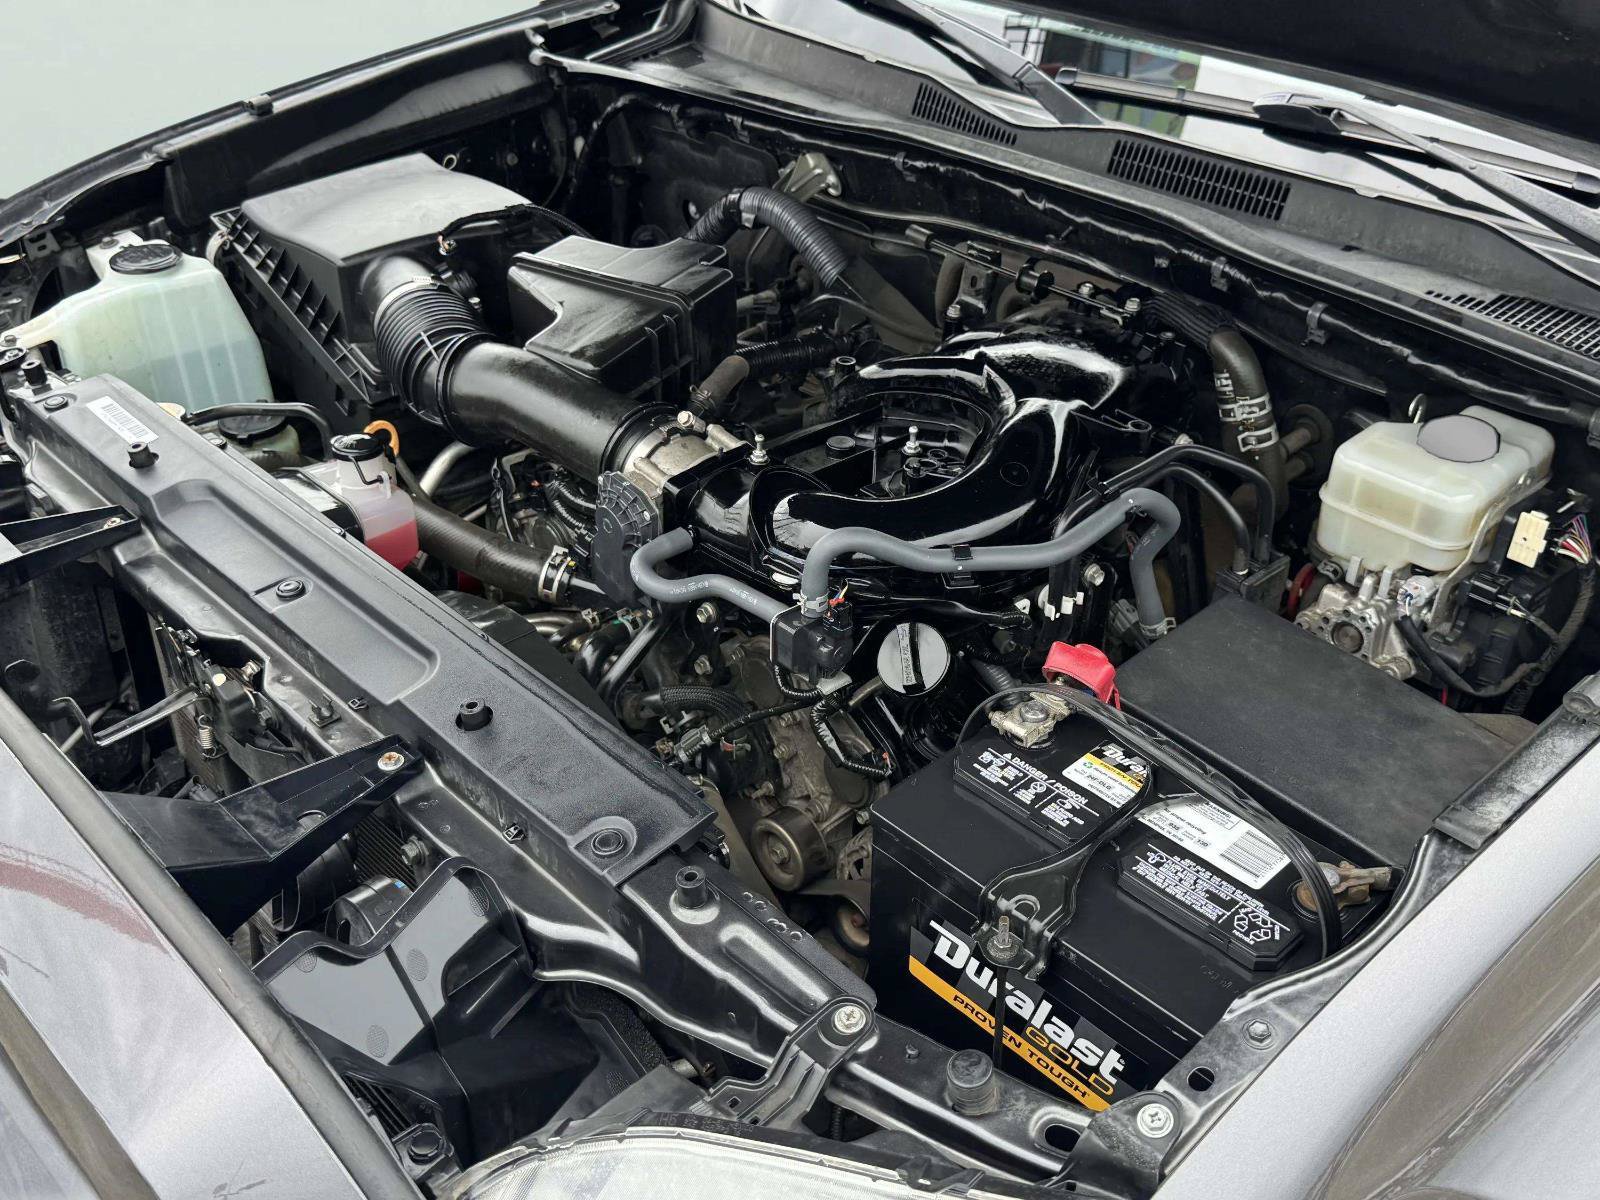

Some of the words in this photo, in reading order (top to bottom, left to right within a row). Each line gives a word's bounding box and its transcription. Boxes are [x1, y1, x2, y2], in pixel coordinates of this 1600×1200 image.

[1012, 757, 1048, 780] DANGER
[1054, 782, 1088, 805] POISON
[929, 919, 1125, 1085] Duralast
[953, 994, 1022, 1050] PROVEN
[1027, 1048, 1089, 1099] TOUGH
[1025, 1026, 1114, 1096] GOLD
